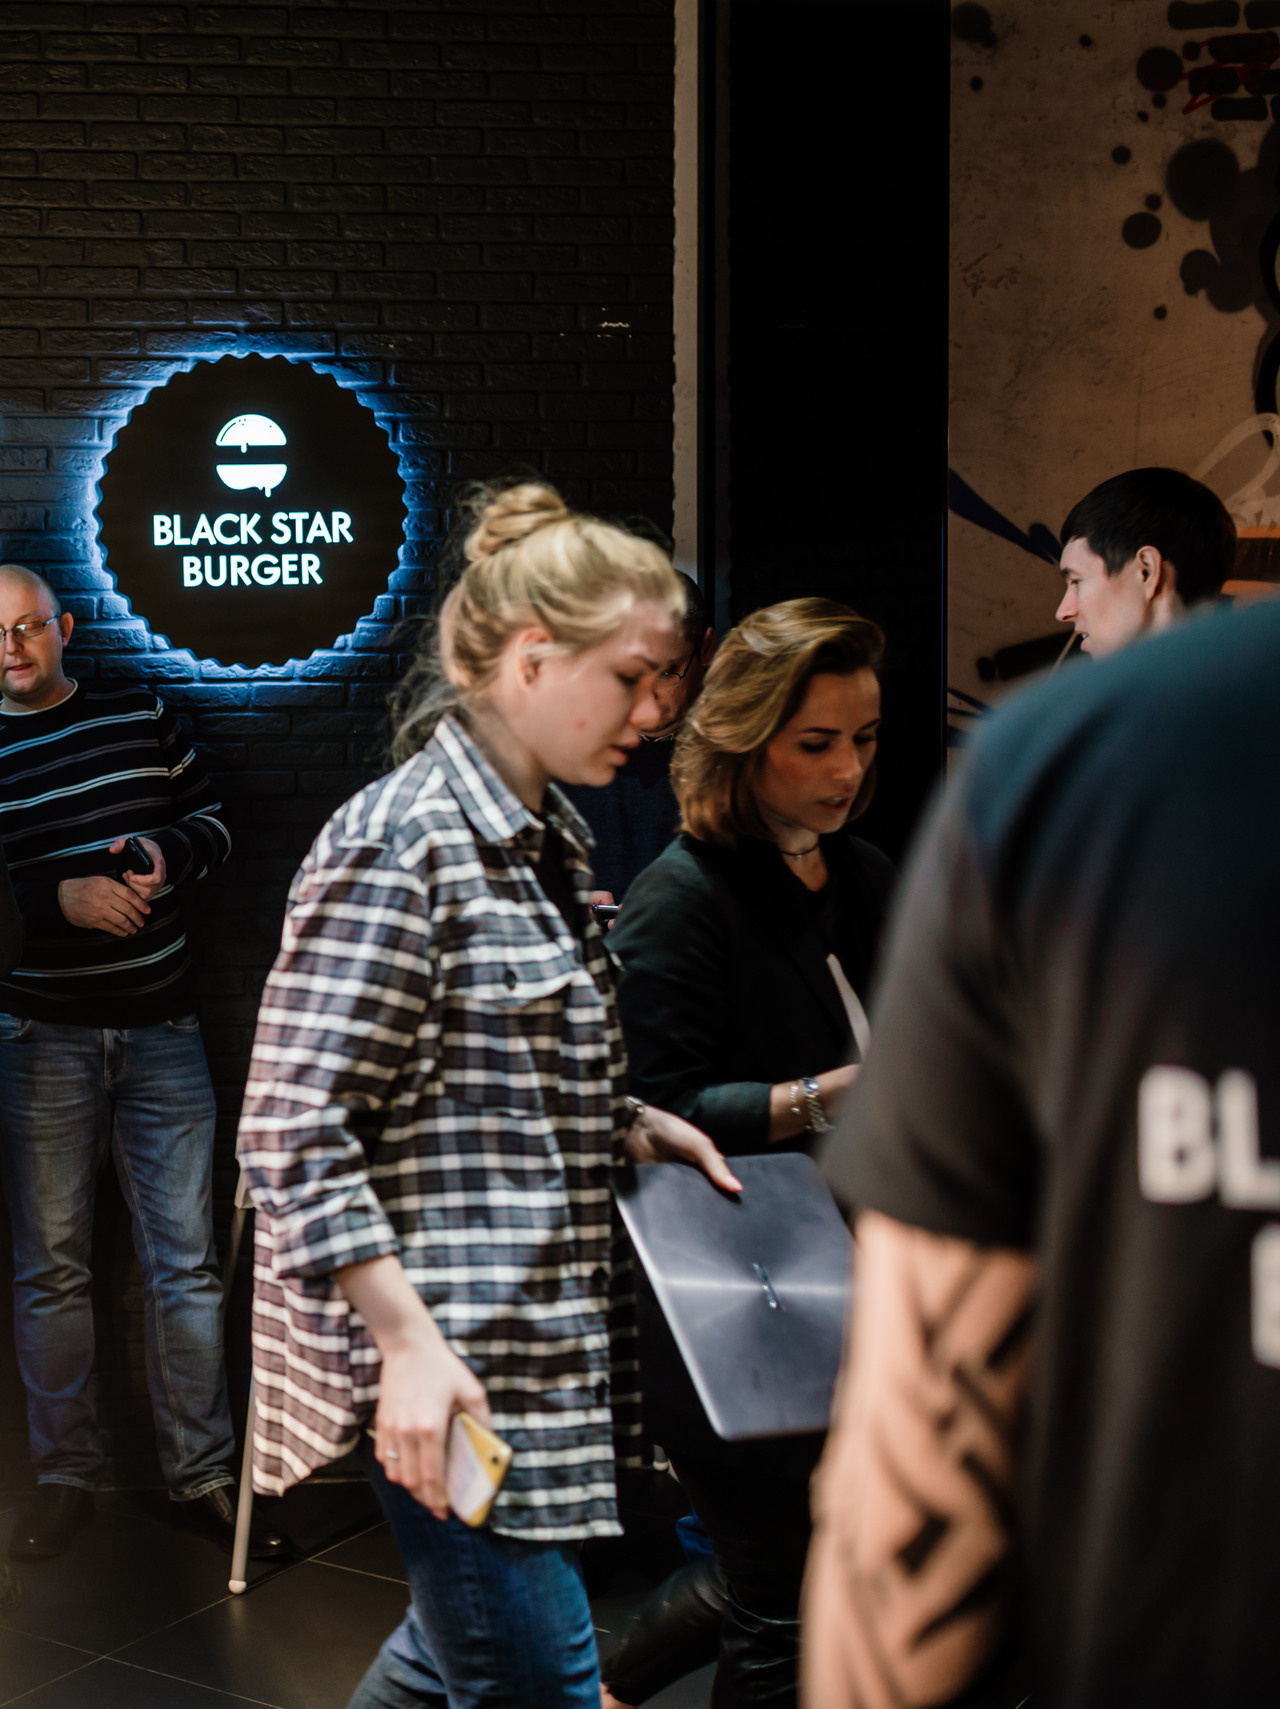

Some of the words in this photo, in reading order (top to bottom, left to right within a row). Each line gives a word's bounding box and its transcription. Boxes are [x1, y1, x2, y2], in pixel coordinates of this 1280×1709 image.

[153, 512, 262, 546] BLACK
[270, 511, 354, 544] STAR
[183, 553, 324, 588] BURGER
